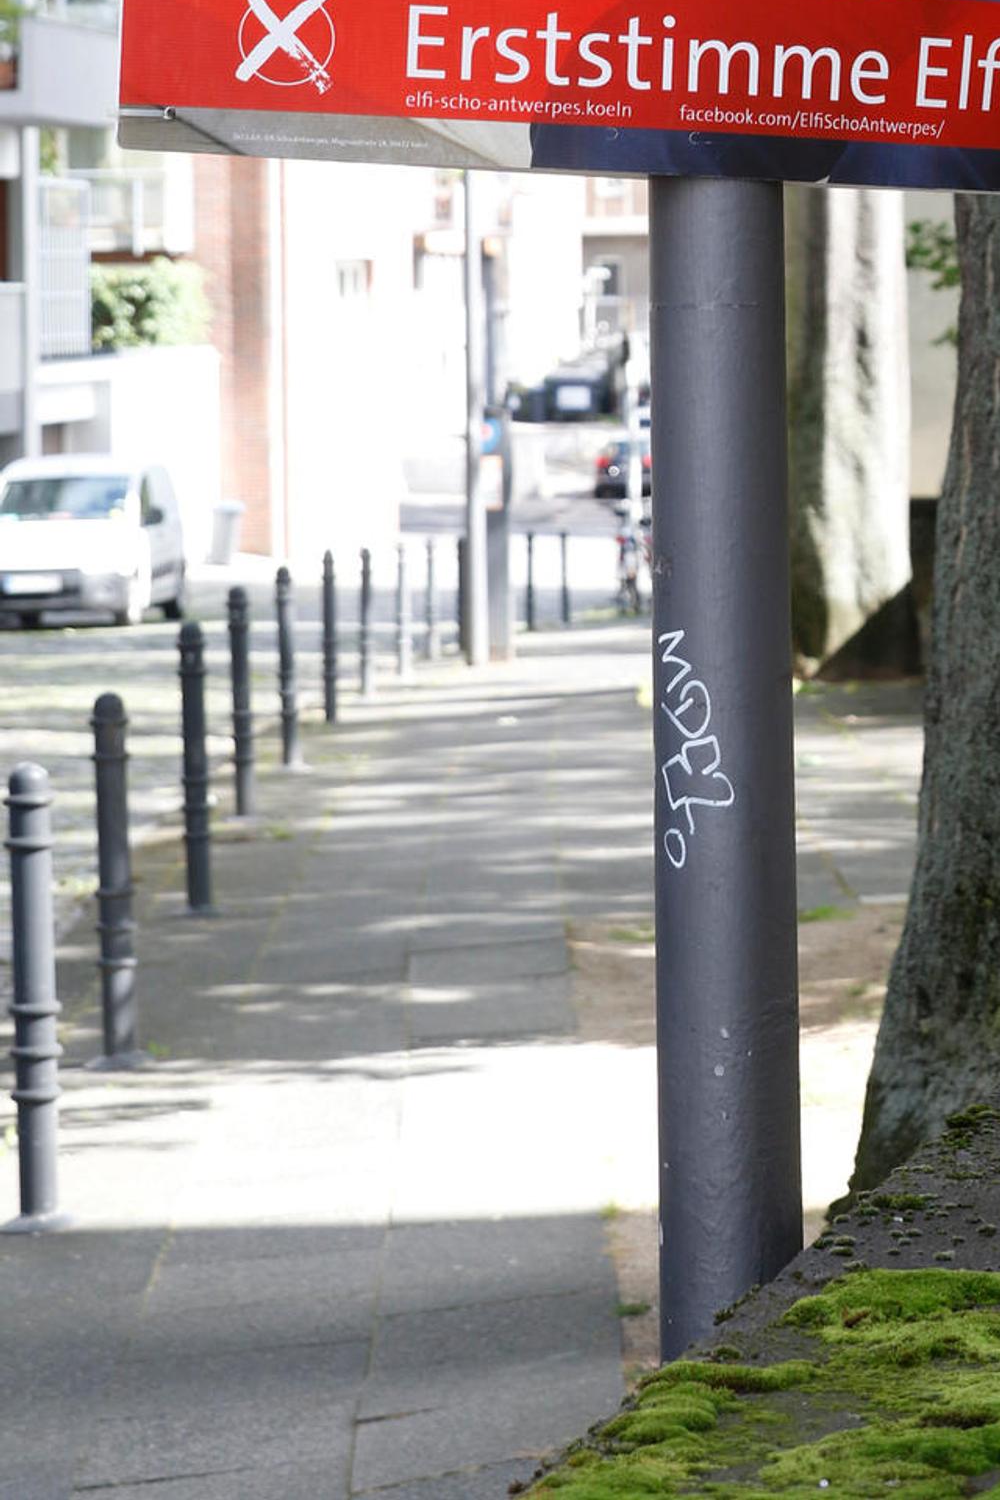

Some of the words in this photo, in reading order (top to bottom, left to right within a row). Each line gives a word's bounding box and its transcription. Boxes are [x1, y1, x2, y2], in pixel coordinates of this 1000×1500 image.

[405, 3, 889, 105] Erststimme
[404, 90, 633, 118] elfi-scho-antwerpes.koeln
[679, 104, 946, 139] facebook.com/ElfiSchoAntwerpes/
